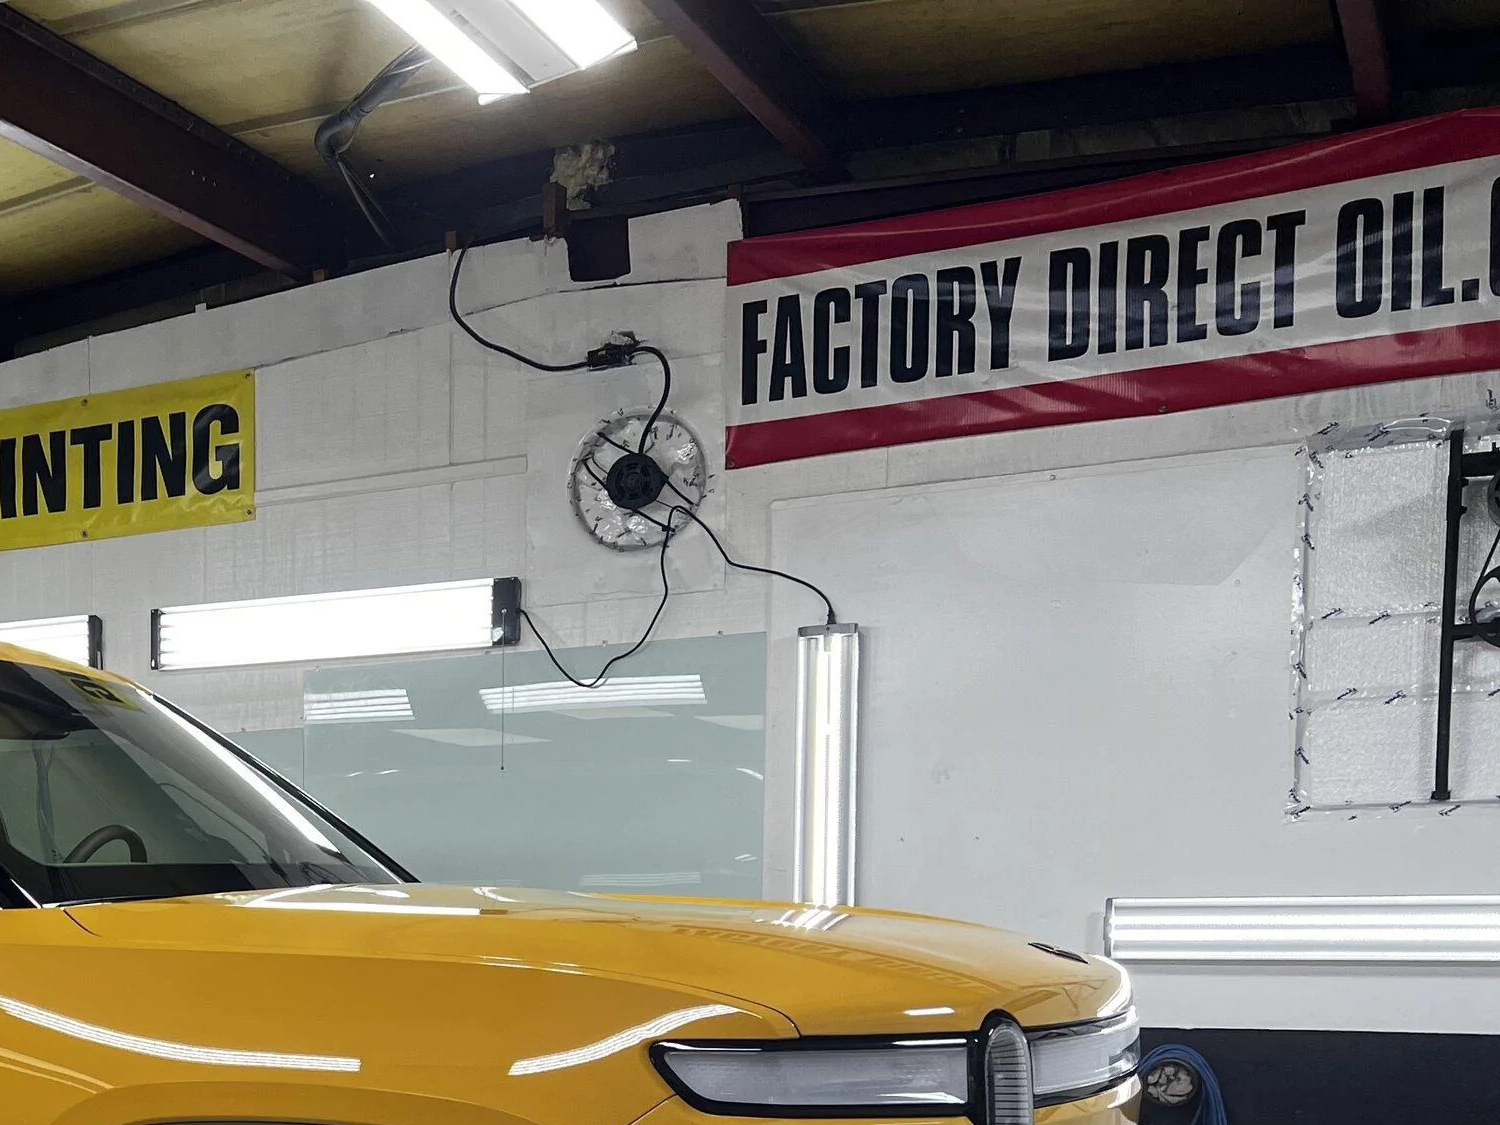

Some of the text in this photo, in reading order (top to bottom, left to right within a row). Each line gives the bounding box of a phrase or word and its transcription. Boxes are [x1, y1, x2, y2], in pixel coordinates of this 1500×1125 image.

[741, 176, 1500, 406] FACTORY DIRECT OIL.
